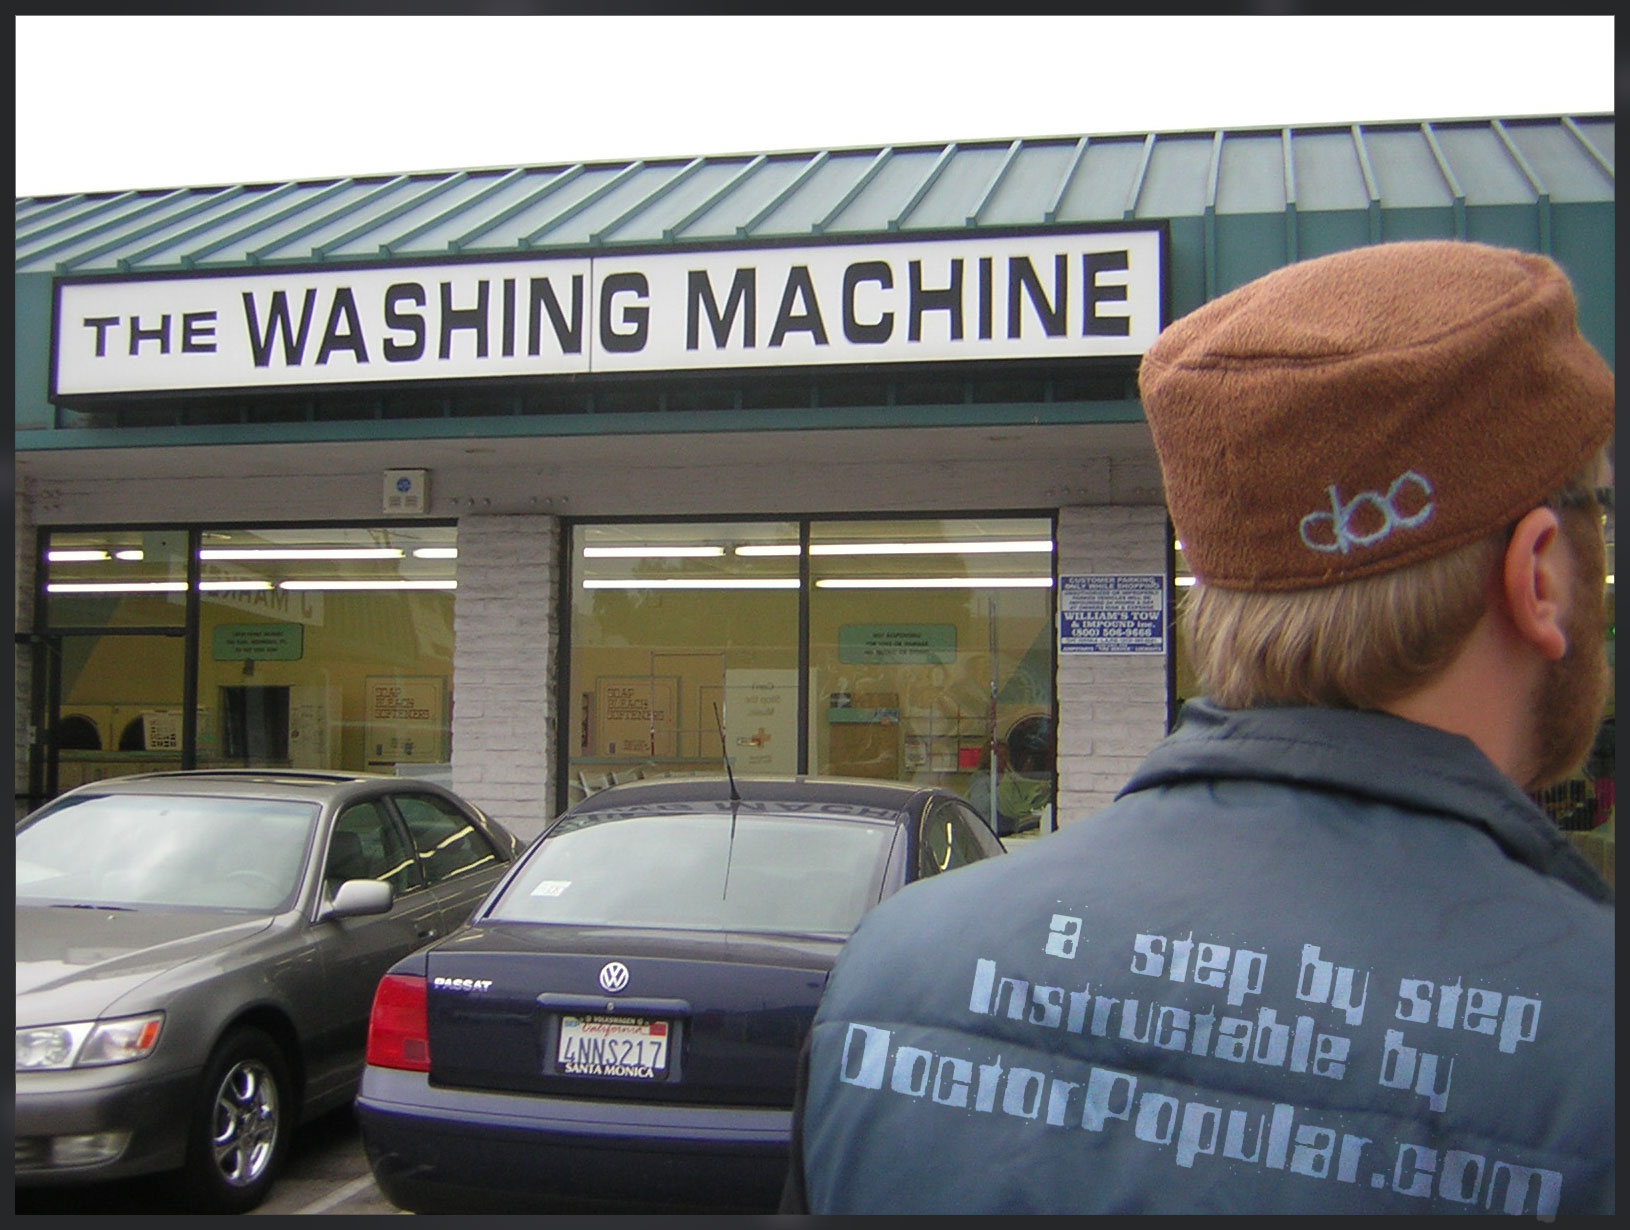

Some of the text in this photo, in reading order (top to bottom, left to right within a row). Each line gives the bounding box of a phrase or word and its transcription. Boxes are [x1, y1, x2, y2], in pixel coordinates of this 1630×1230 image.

[83, 250, 1131, 368] THE WASHING MACHINE
[1299, 470, 1434, 554] doc
[1064, 612, 1160, 620] WILLIAM'S TOW
[1072, 629, 1100, 637] (800)
[434, 977, 493, 992] PASSAT
[582, 1023, 643, 1037] California
[564, 1037, 662, 1069] 4NNS217
[565, 1062, 655, 1078] SANTA MONICA
